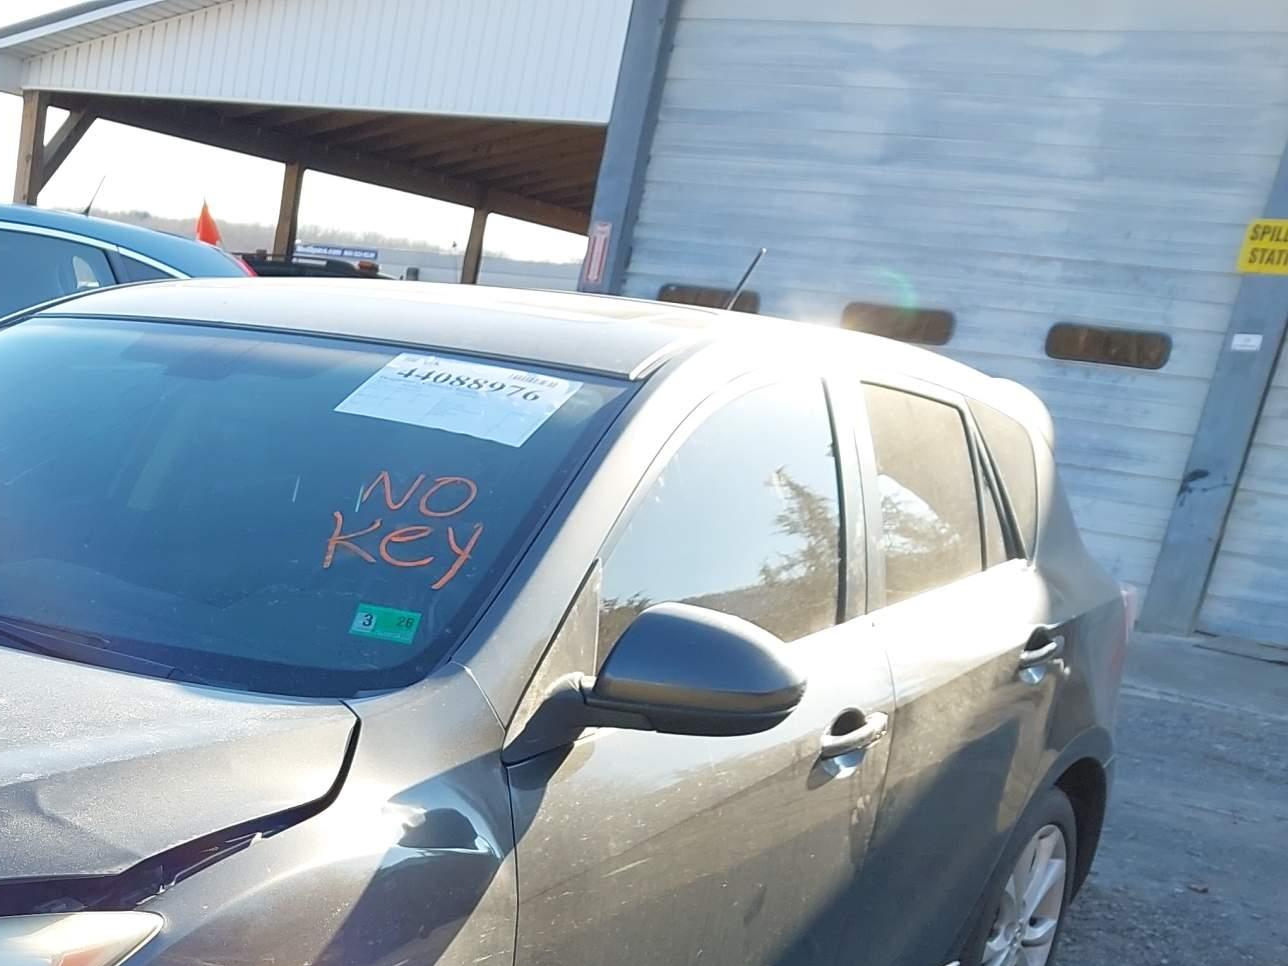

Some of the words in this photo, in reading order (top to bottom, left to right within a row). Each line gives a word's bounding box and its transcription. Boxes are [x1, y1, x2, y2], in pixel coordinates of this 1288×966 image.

[397, 366, 541, 402] 44088976
[361, 470, 479, 518] NO
[363, 614, 374, 627] 3
